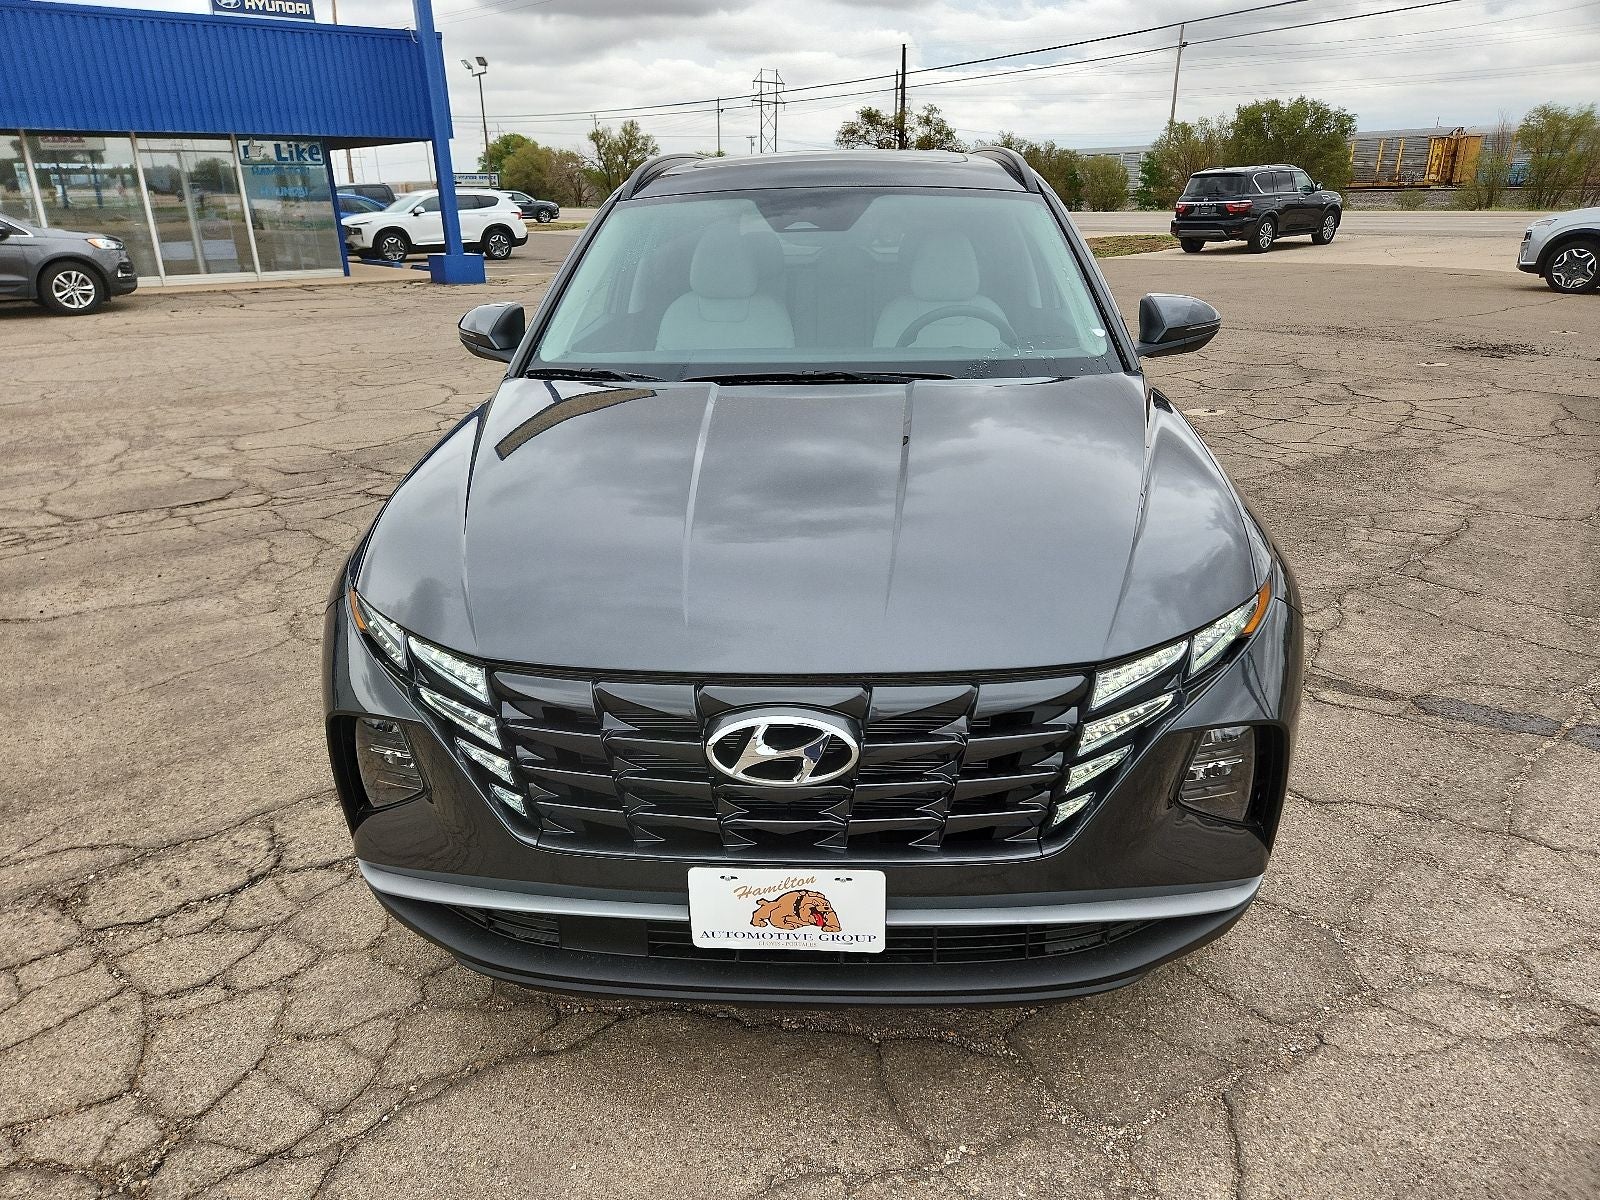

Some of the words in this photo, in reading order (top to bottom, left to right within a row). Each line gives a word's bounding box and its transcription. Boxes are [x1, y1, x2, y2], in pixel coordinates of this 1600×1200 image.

[244, 0, 311, 15] HYUNDAI
[274, 143, 322, 162] Like
[733, 875, 817, 900] Hamilton
[700, 930, 814, 942] AUTOMOTIVE
[818, 934, 877, 944] GROUP
